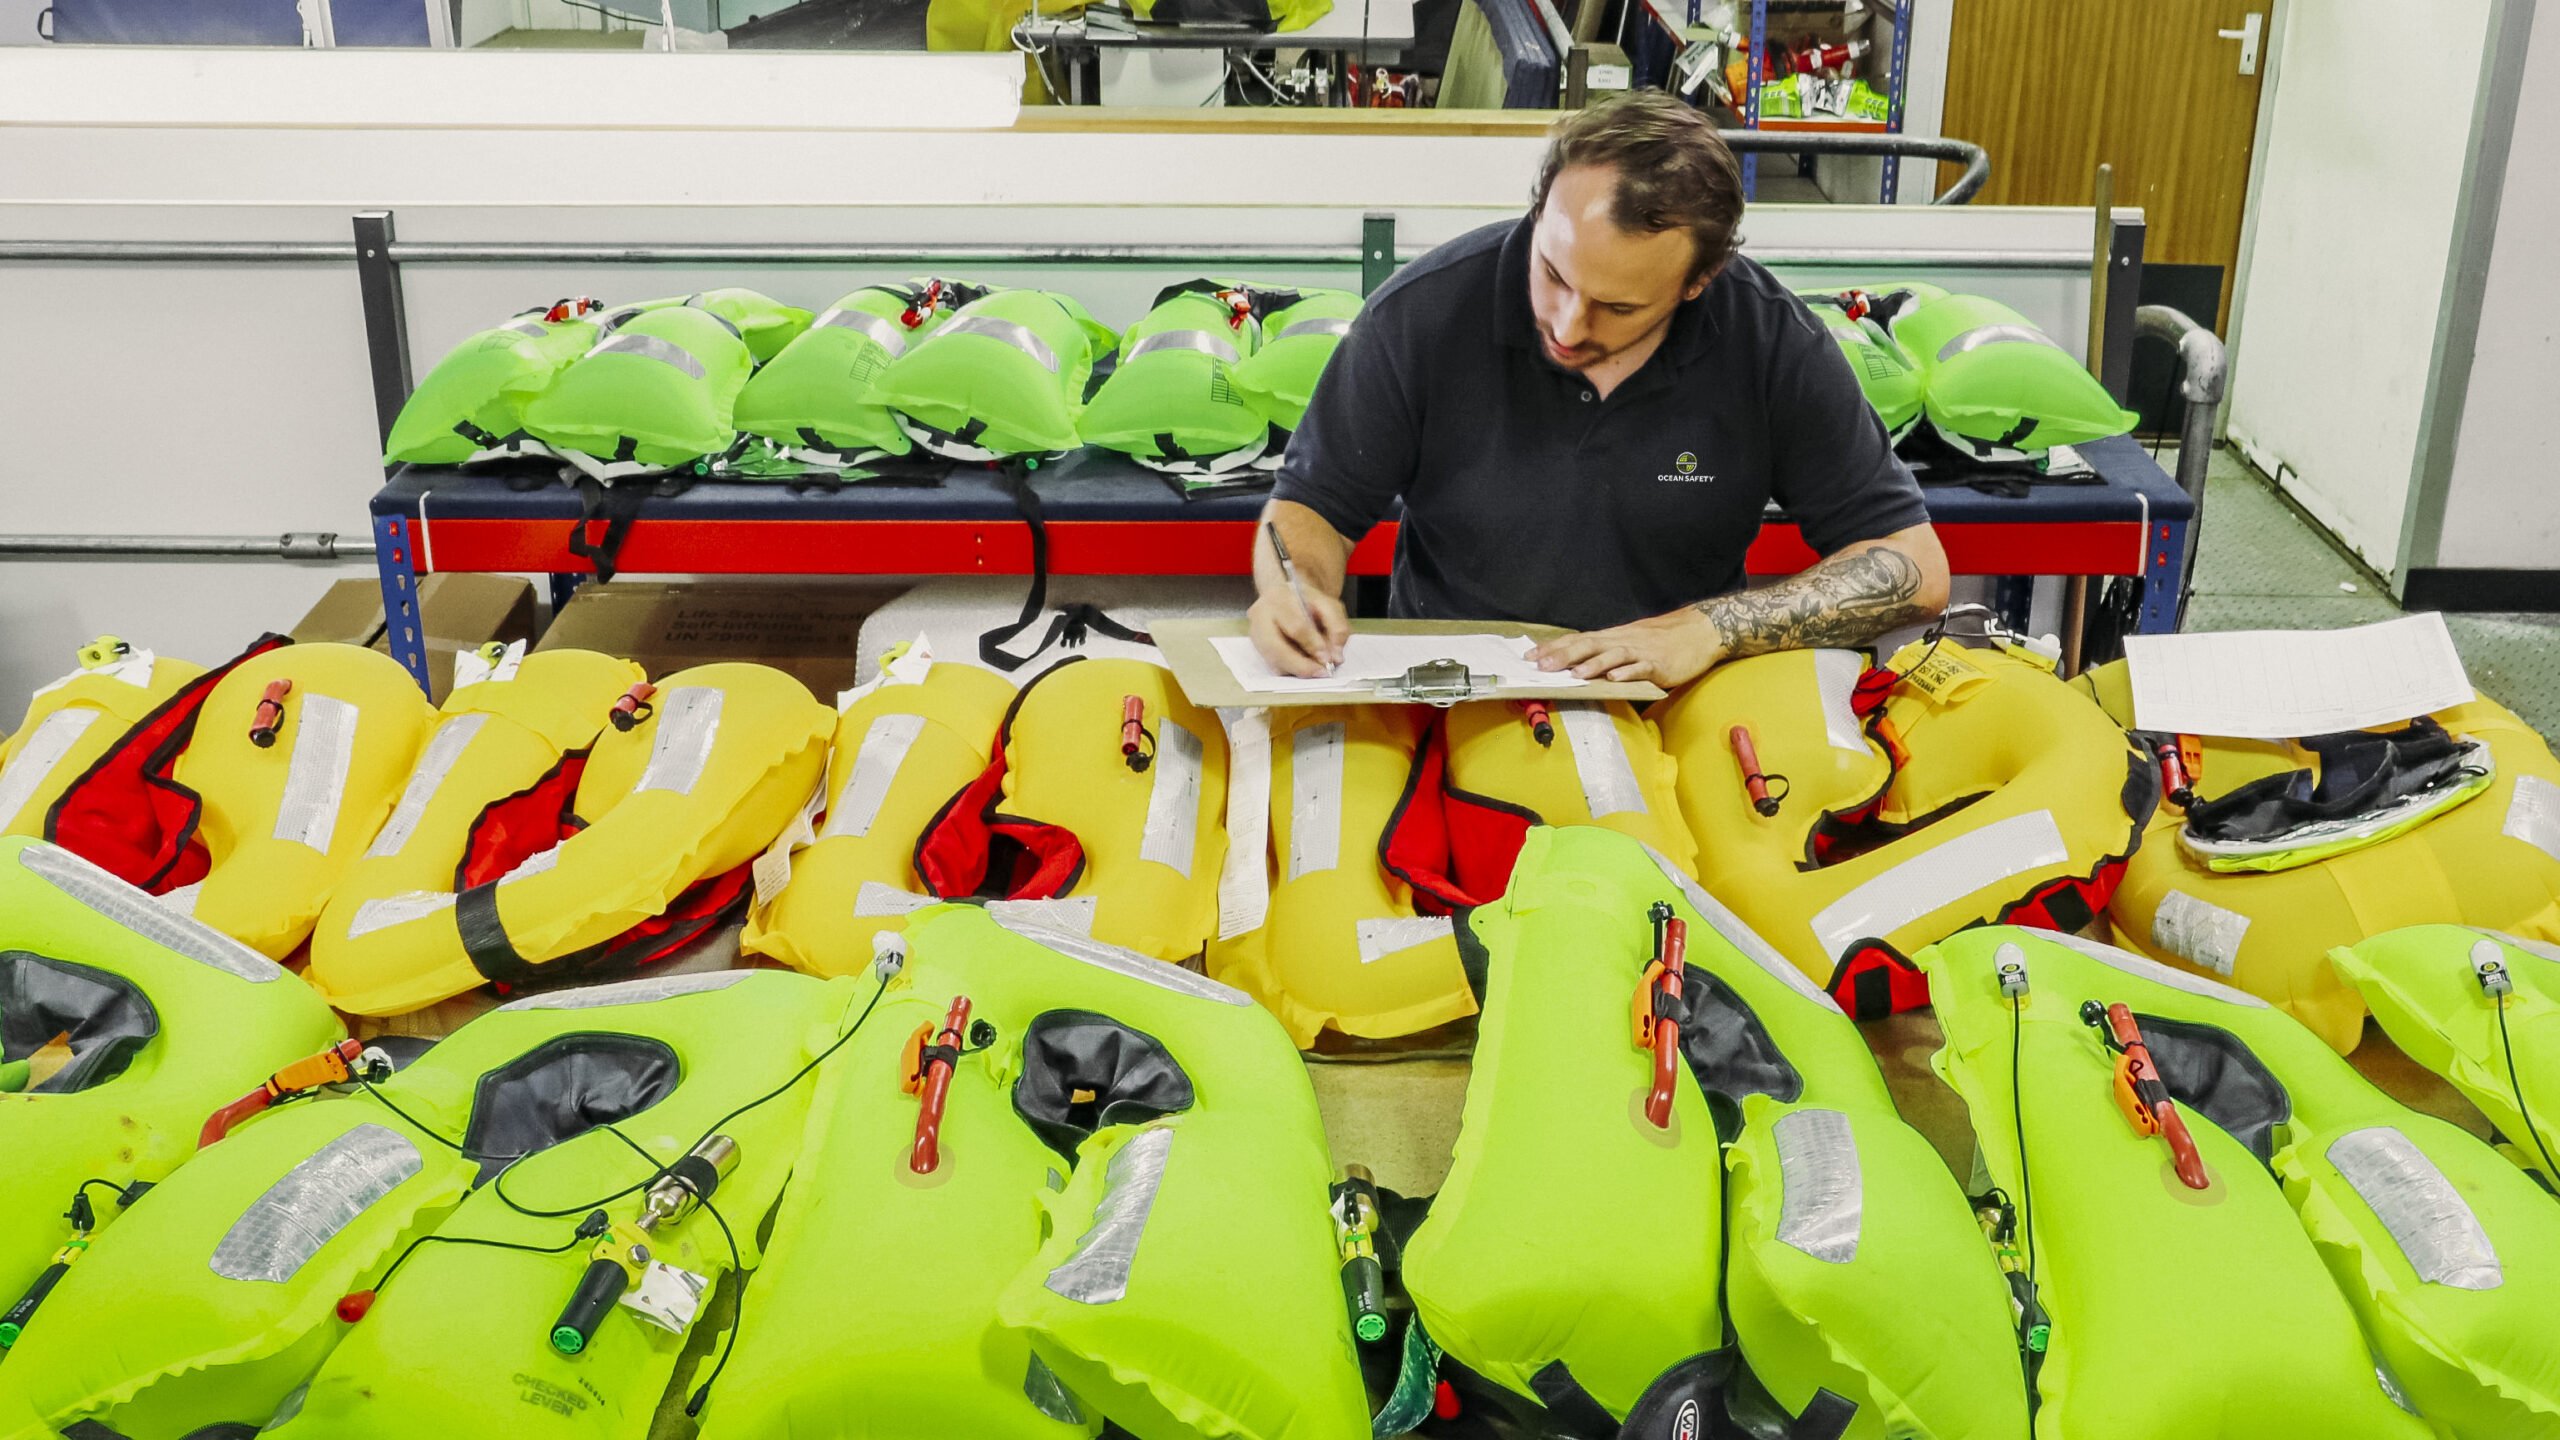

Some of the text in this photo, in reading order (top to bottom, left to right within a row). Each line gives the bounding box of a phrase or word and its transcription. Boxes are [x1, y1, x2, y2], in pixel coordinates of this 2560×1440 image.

[1657, 474, 1683, 482] OCEAN
[664, 632, 699, 642] UN
[512, 1373, 587, 1410] CHECKED
[520, 1390, 574, 1417] LEVEN
